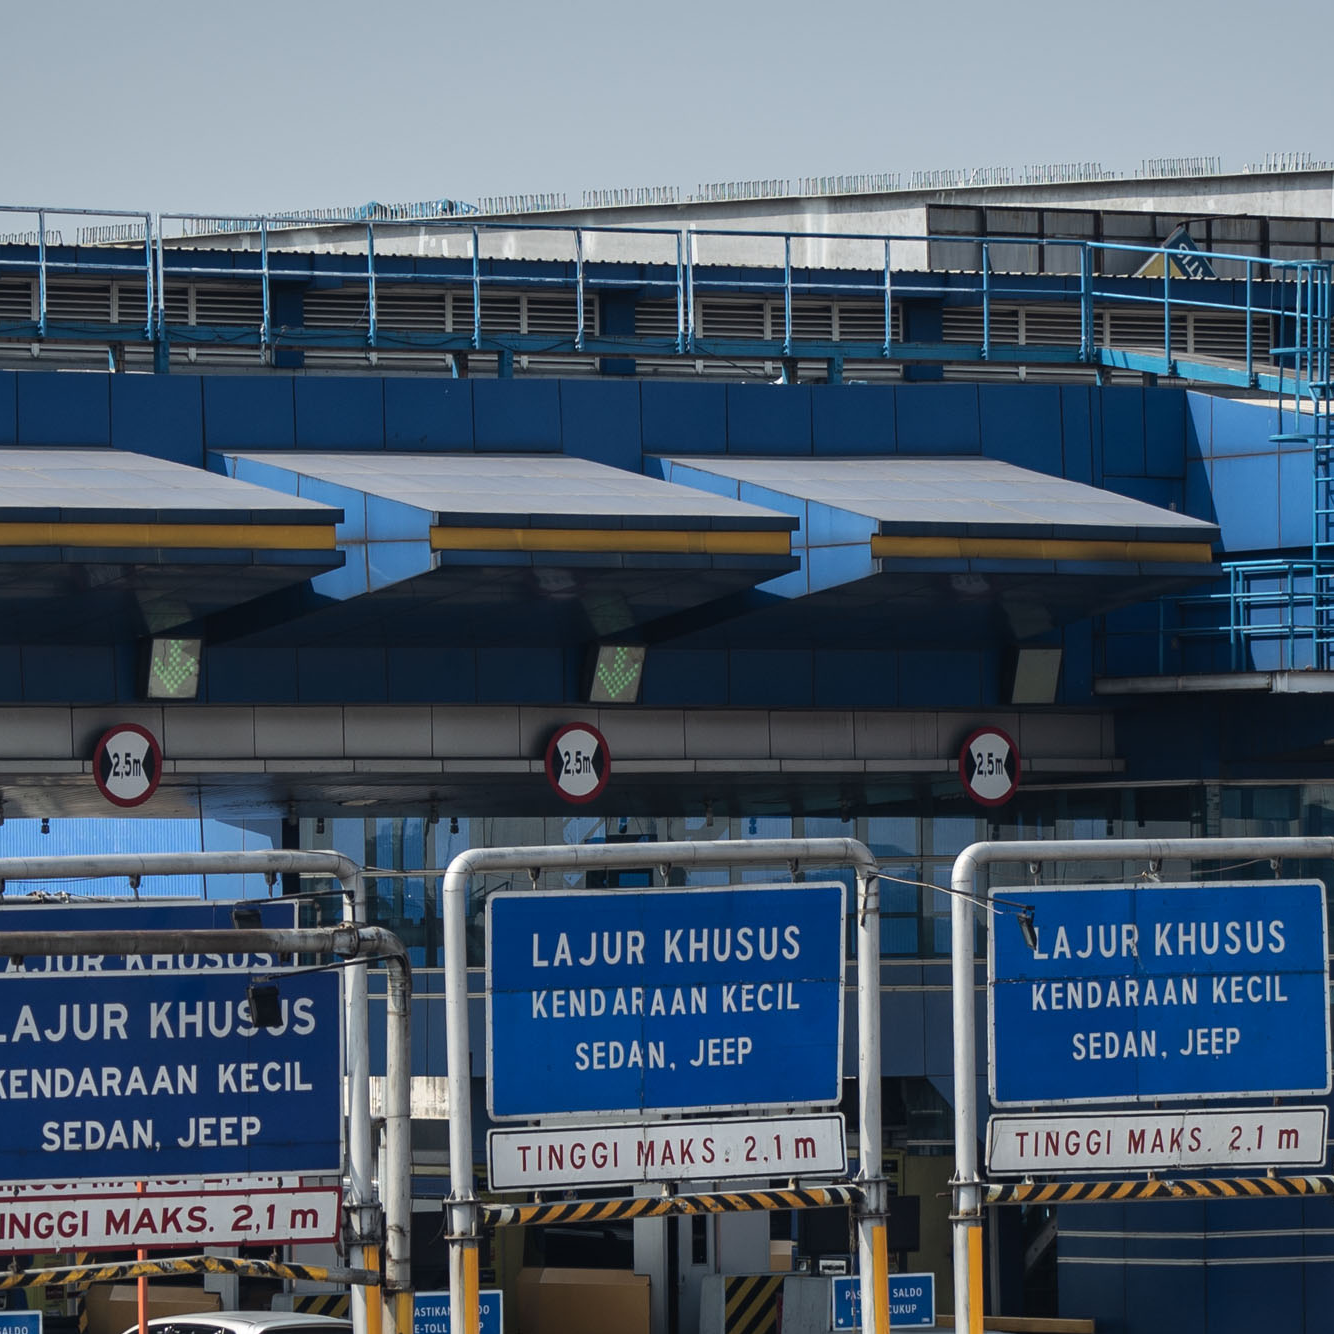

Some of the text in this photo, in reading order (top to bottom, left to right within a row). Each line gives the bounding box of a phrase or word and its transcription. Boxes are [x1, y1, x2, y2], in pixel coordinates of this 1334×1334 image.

[533, 926, 799, 966] LAJUR KHUSUS
[1034, 920, 1285, 959] LAJUR KHUSUS
[533, 983, 799, 1018] KENDARAAN KECIL
[1033, 976, 1287, 1010] KENDARAAN KECIL
[151, 998, 315, 1038] KHUSUS
[576, 1037, 752, 1070] SEDAN, JEEP
[1073, 1028, 1240, 1060] SEDAN, JEEP
[219, 1062, 312, 1093] KECIL
[42, 1117, 260, 1151] SEDAN, JEEP
[1016, 1130, 1110, 1157] TINGGI
[1128, 1128, 1211, 1153] MAKS.
[1278, 1129, 1298, 1149] m
[518, 1142, 617, 1171] TINGGI
[638, 1138, 729, 1171] MAKS.
[106, 1206, 213, 1235] MAKS.
[291, 1209, 318, 1228] m
[893, 1287, 923, 1298] SALDO
[414, 1323, 447, 1334] E-TOLL
